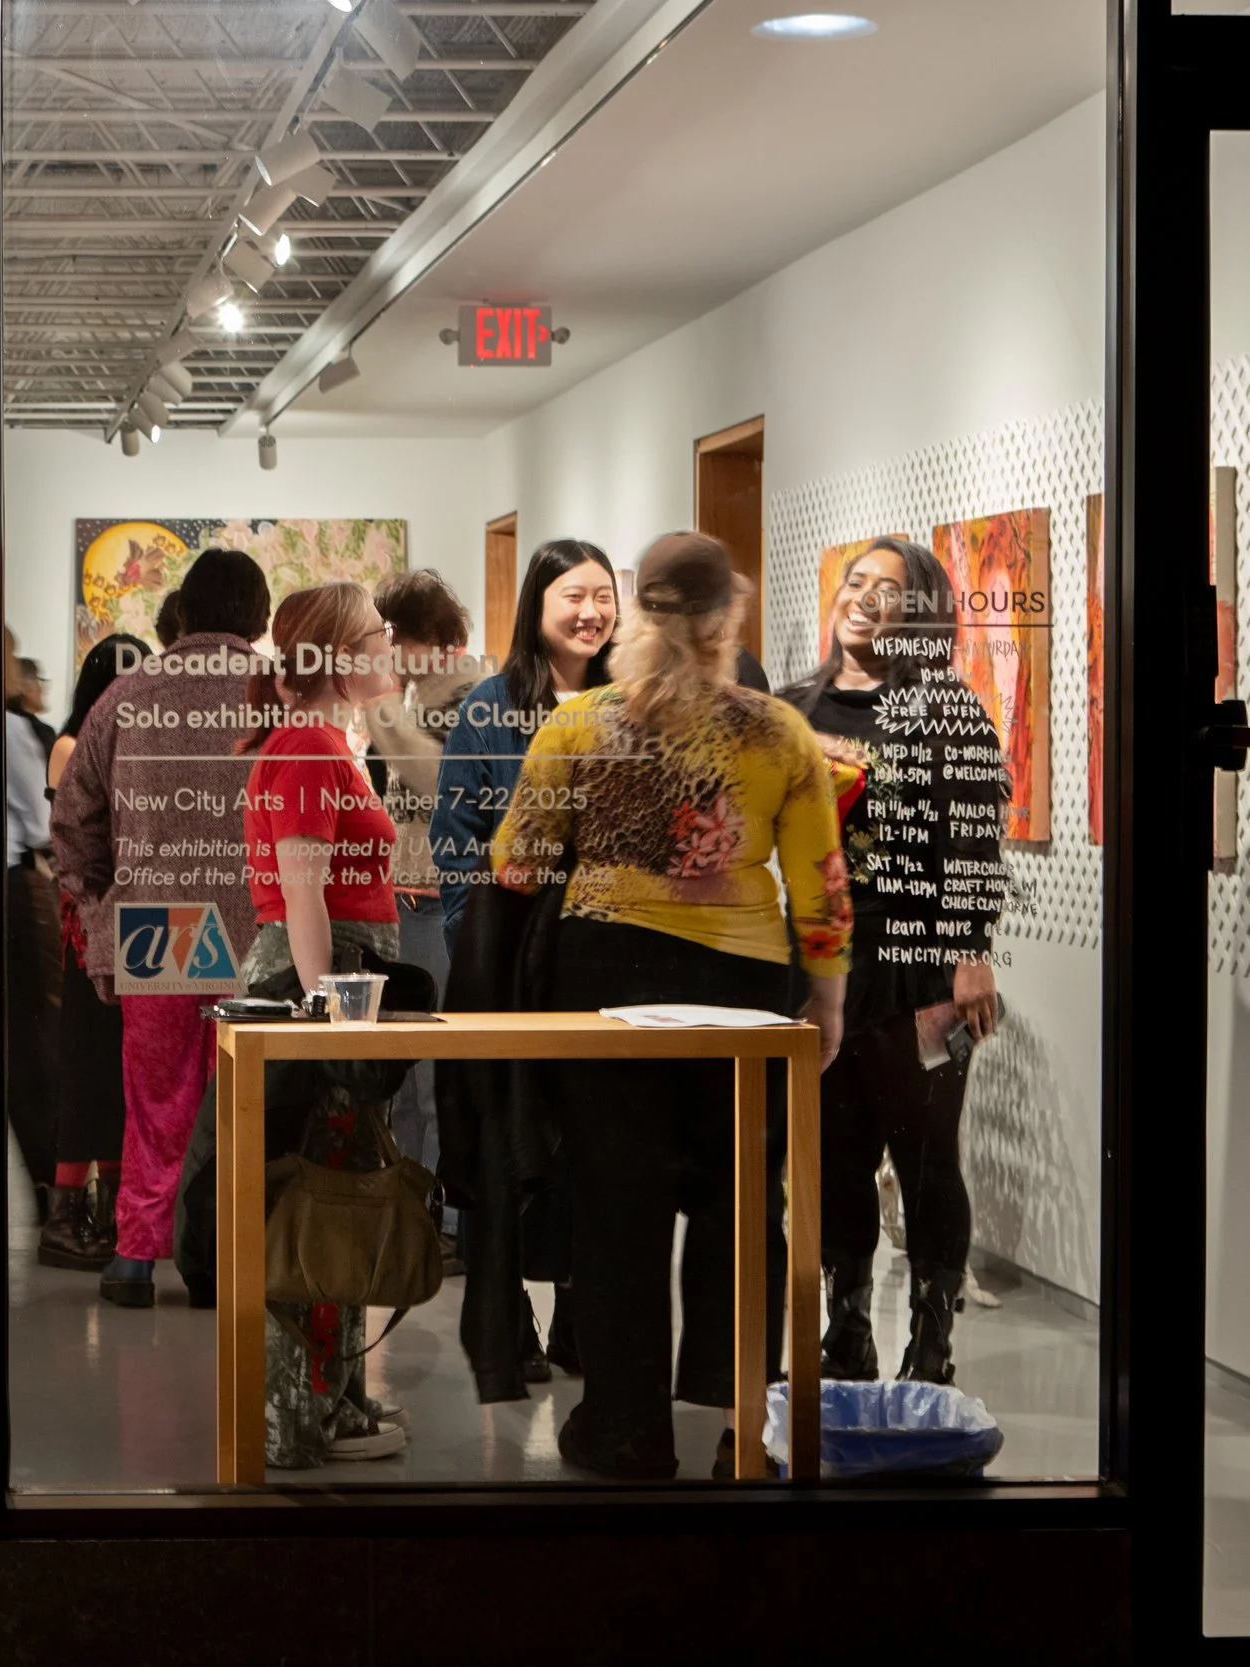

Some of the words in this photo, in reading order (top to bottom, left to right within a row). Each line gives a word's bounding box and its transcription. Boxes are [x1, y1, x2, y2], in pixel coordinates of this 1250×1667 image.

[475, 307, 541, 359] EXIT
[861, 590, 938, 613] OPEN
[946, 590, 1045, 613] HOURS
[871, 637, 952, 660] WEDNESDAY
[115, 643, 286, 676] Decadent
[296, 643, 499, 676] Dissolution
[920, 667, 931, 684] 10
[116, 702, 180, 728] Solo
[187, 703, 324, 728] exhibition
[332, 703, 367, 735] by
[374, 701, 460, 728] Chloe
[466, 701, 616, 735] Clayborne
[890, 705, 928, 717] FREE
[943, 705, 993, 719] EVEN
[882, 742, 908, 760] WED
[911, 742, 932, 764] 11/12
[942, 763, 1007, 782] @WELCOME
[114, 788, 168, 811] New
[174, 788, 225, 817] City
[233, 788, 284, 811] Arts
[320, 788, 444, 811] November
[519, 787, 588, 810] 2025
[867, 800, 886, 818] FRI
[918, 800, 938, 821] 11/21
[949, 801, 995, 819] ANALOG
[950, 822, 1009, 840] FRIDAYS
[115, 838, 154, 857] This
[159, 839, 251, 857] exhibition
[256, 841, 271, 857] is
[378, 838, 403, 861] by
[408, 837, 458, 856] UVA
[511, 837, 527, 856] &
[533, 837, 564, 856] the
[867, 853, 892, 872] SAT
[896, 854, 924, 874] 11/22
[943, 858, 1014, 878] WATERCOLOR
[114, 866, 175, 885] Office
[180, 866, 200, 885] of
[206, 868, 236, 885] the
[240, 867, 314, 885] Provost
[319, 867, 335, 885] &
[341, 867, 372, 885] the
[378, 866, 421, 885] Vice
[425, 867, 498, 885] Provost
[504, 866, 532, 885] for
[535, 867, 567, 885] the
[943, 878, 984, 894] CRAFT
[985, 878, 1017, 895] HOUR
[941, 895, 976, 910] CHLOE
[976, 897, 1038, 917] CLAYORNE
[886, 917, 927, 936] learn
[935, 919, 972, 936] more
[119, 981, 183, 991] UNIVERSITY
[191, 981, 243, 991] VIRGINIA
